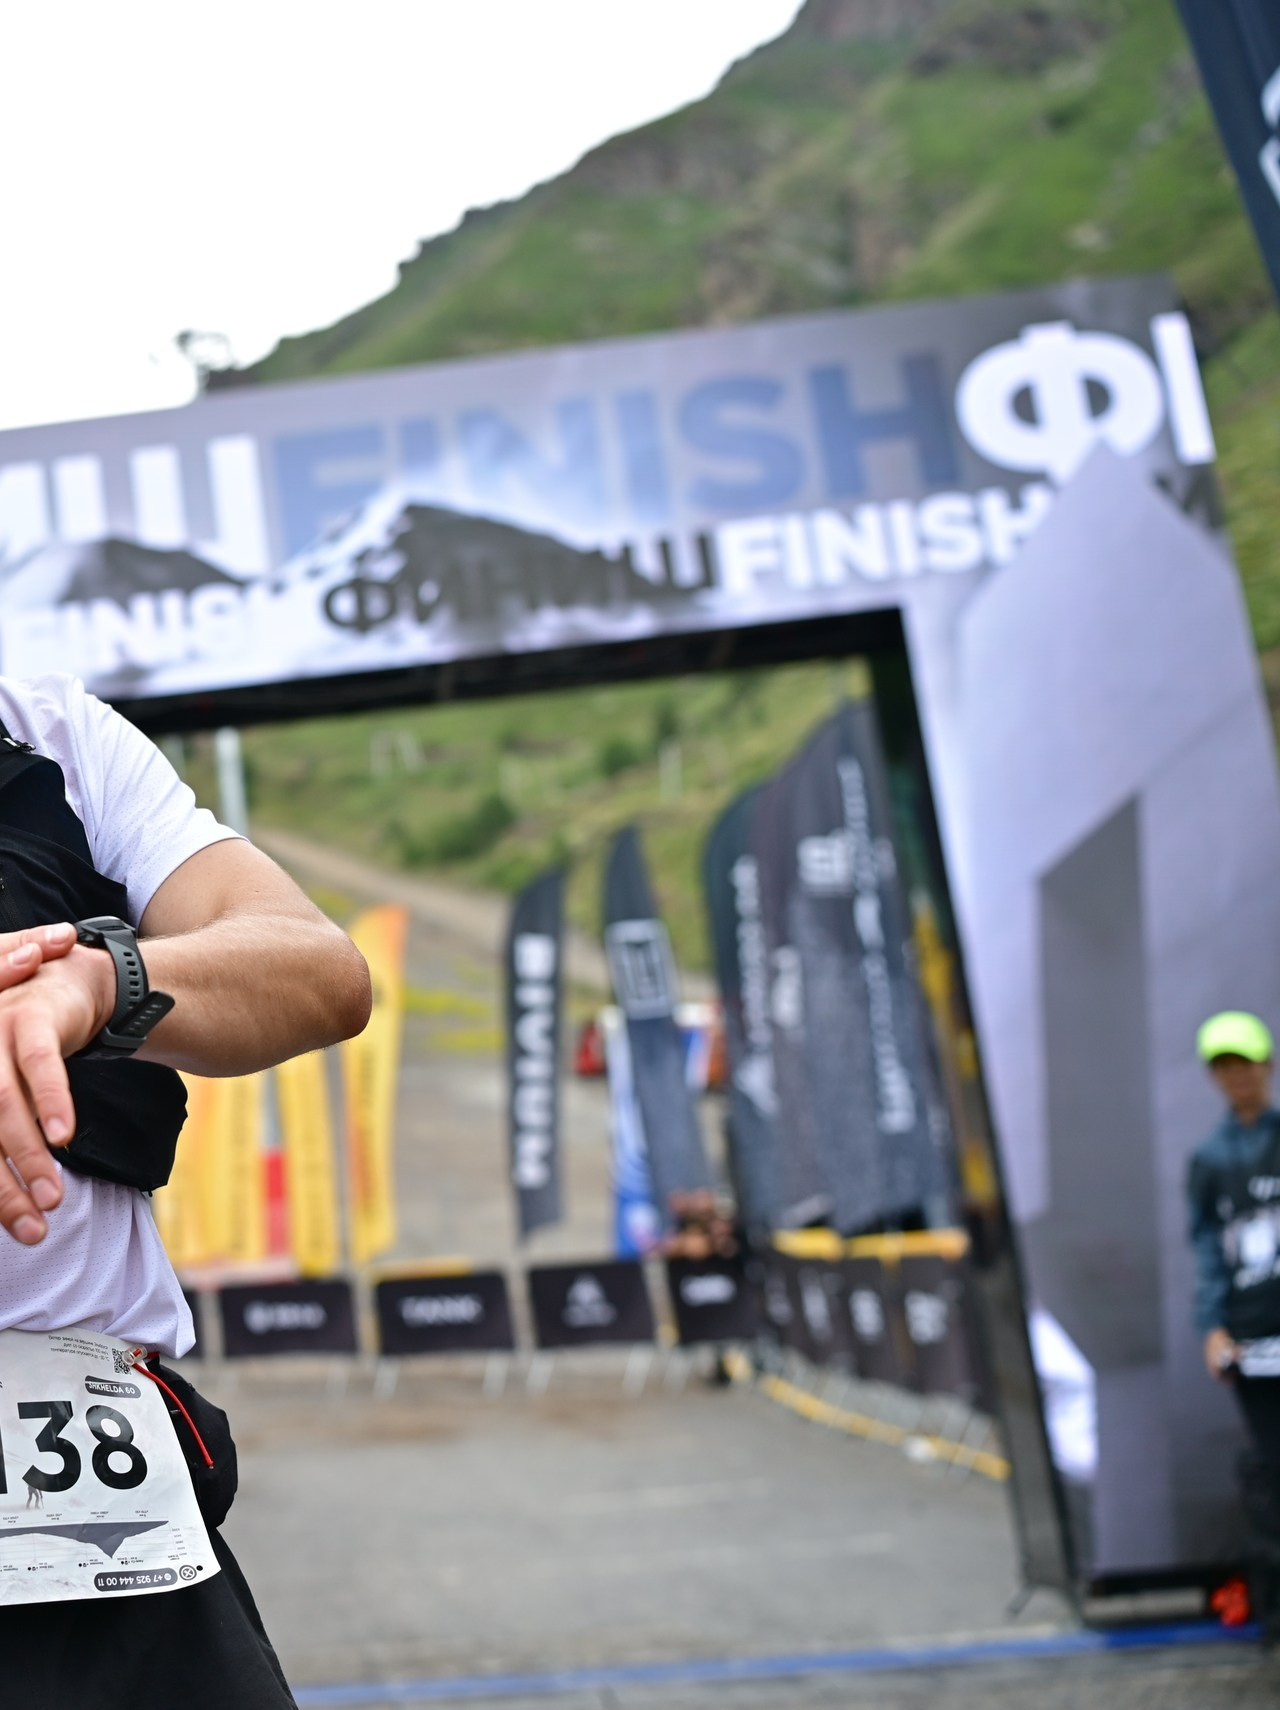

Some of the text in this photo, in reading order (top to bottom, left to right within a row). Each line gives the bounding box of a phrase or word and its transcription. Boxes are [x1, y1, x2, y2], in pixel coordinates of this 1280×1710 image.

[125, 1386, 136, 1394] 60
[98, 1574, 163, 1587] +7 925 444 00 11
